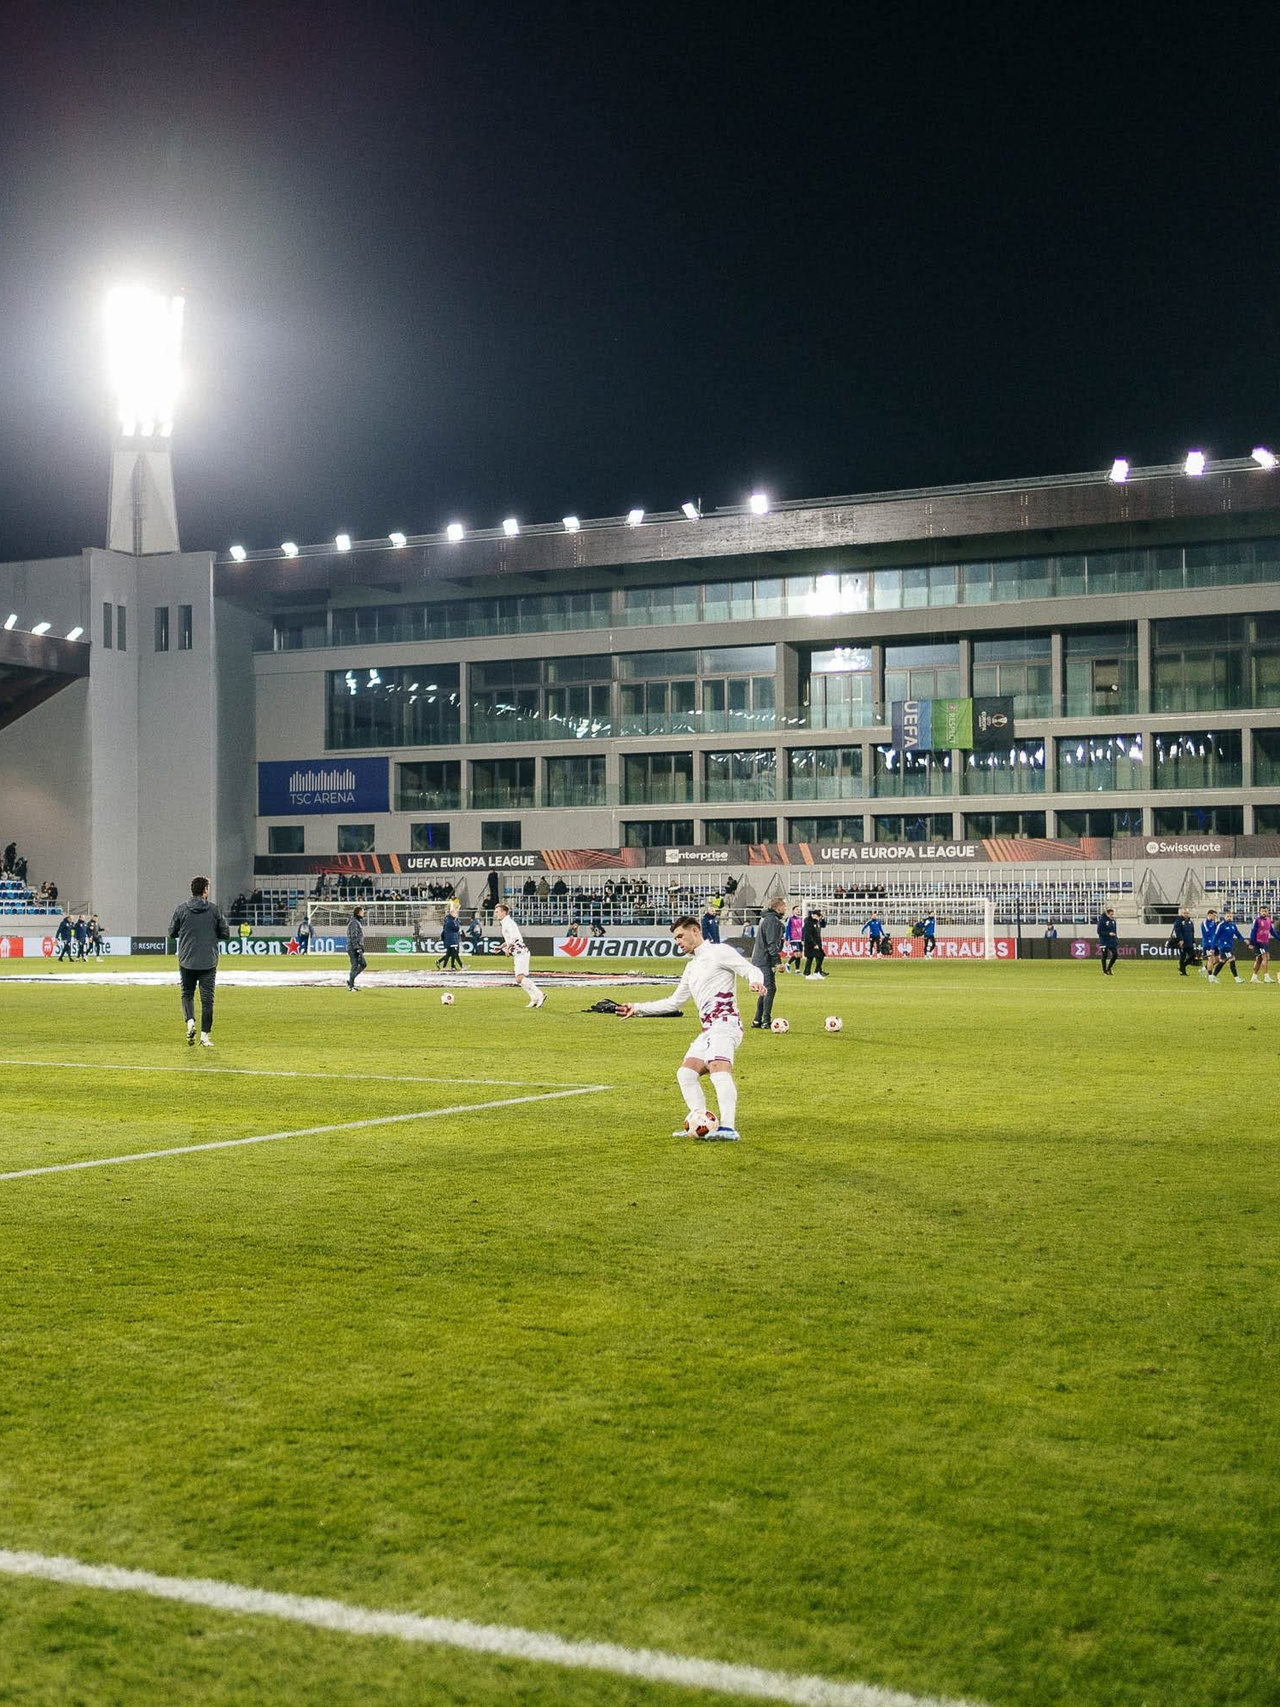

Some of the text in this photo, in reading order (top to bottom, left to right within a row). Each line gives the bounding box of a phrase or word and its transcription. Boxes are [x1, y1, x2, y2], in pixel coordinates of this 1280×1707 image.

[904, 701, 918, 748] UEFA
[290, 792, 355, 805] TSC ARENA
[821, 845, 975, 859] UEFA EUROPA LEAGUE
[1159, 842, 1221, 854] Swissquote
[407, 855, 535, 869] UEFA EUROPA LEAGUE
[138, 942, 164, 950] RESPECT
